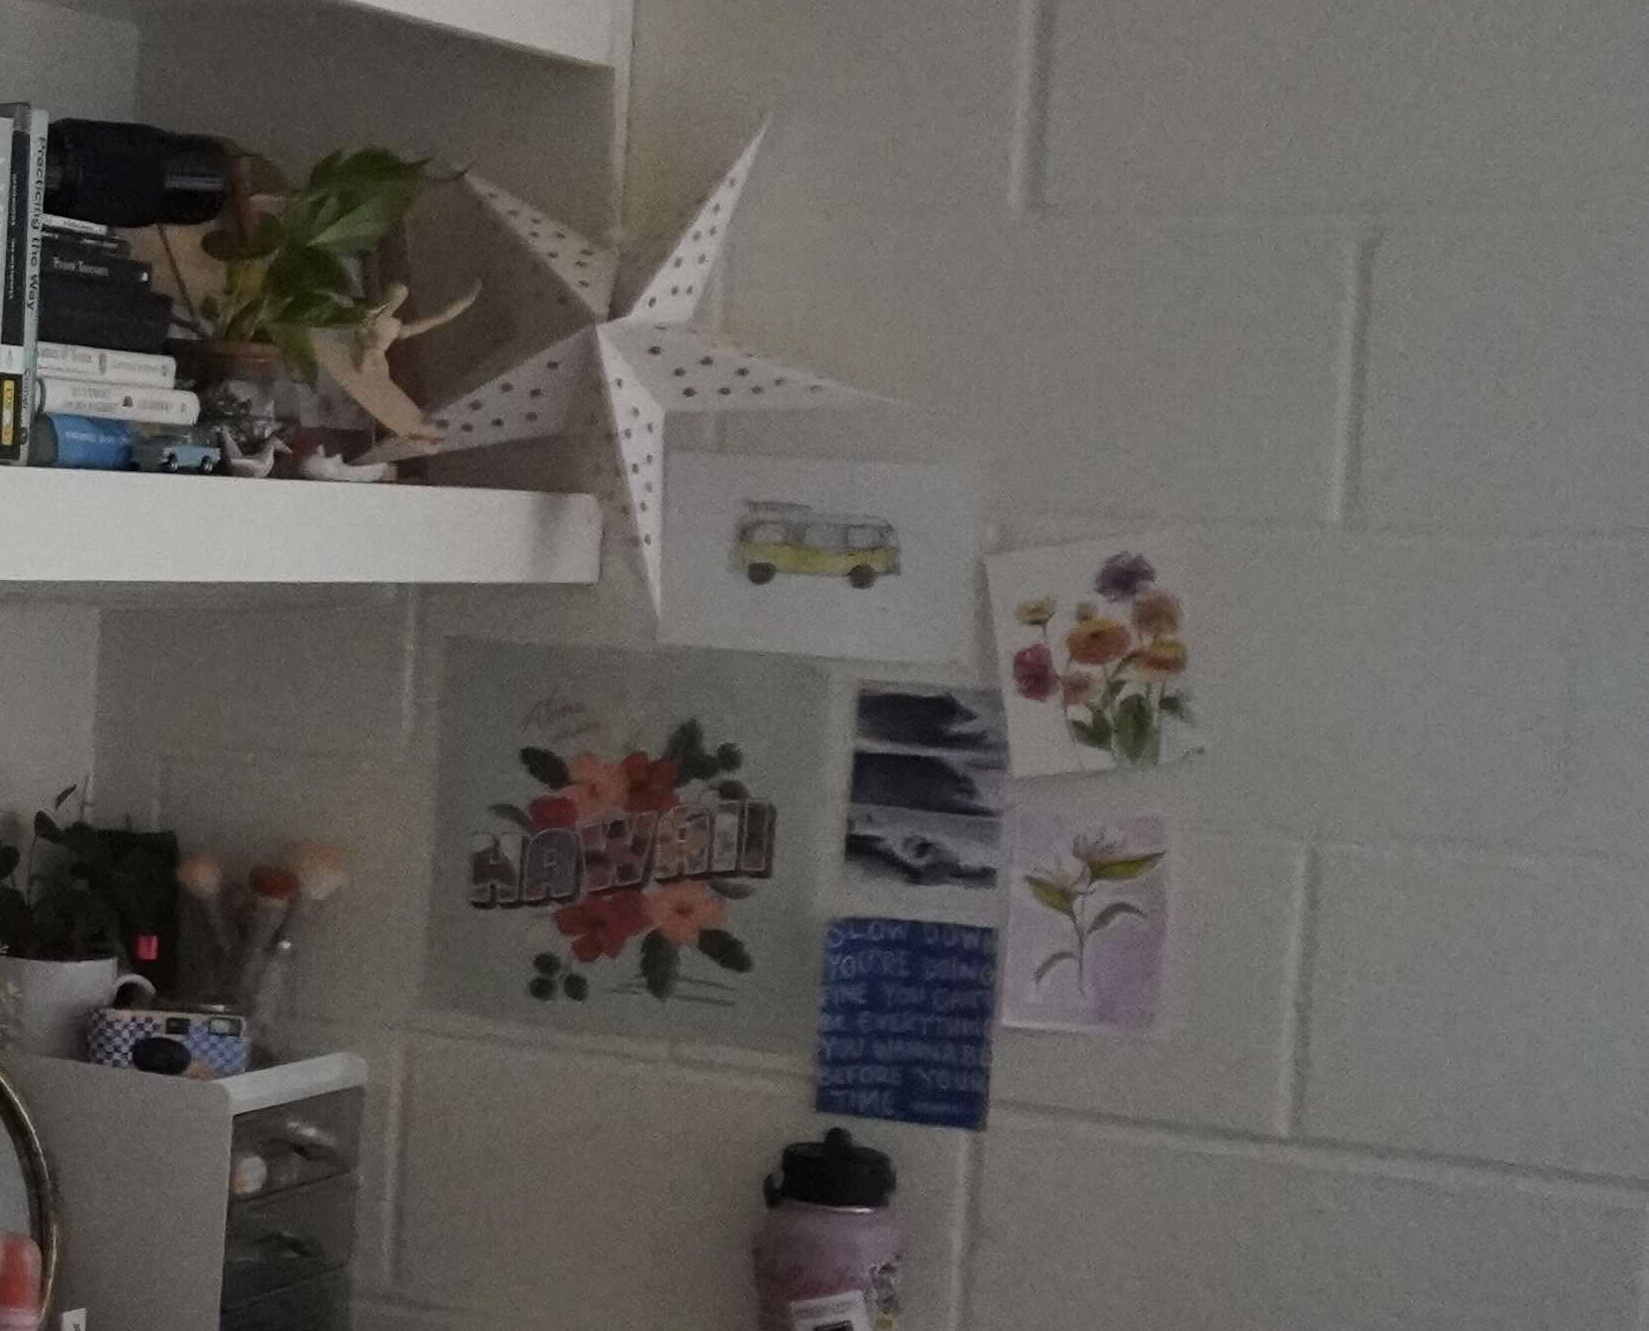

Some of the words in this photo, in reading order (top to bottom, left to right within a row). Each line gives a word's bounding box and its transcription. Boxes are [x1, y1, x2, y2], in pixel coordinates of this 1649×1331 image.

[32, 137, 46, 230] Practicing
[31, 237, 41, 267] the
[27, 274, 38, 311] Way
[469, 798, 777, 909] HAWAII
